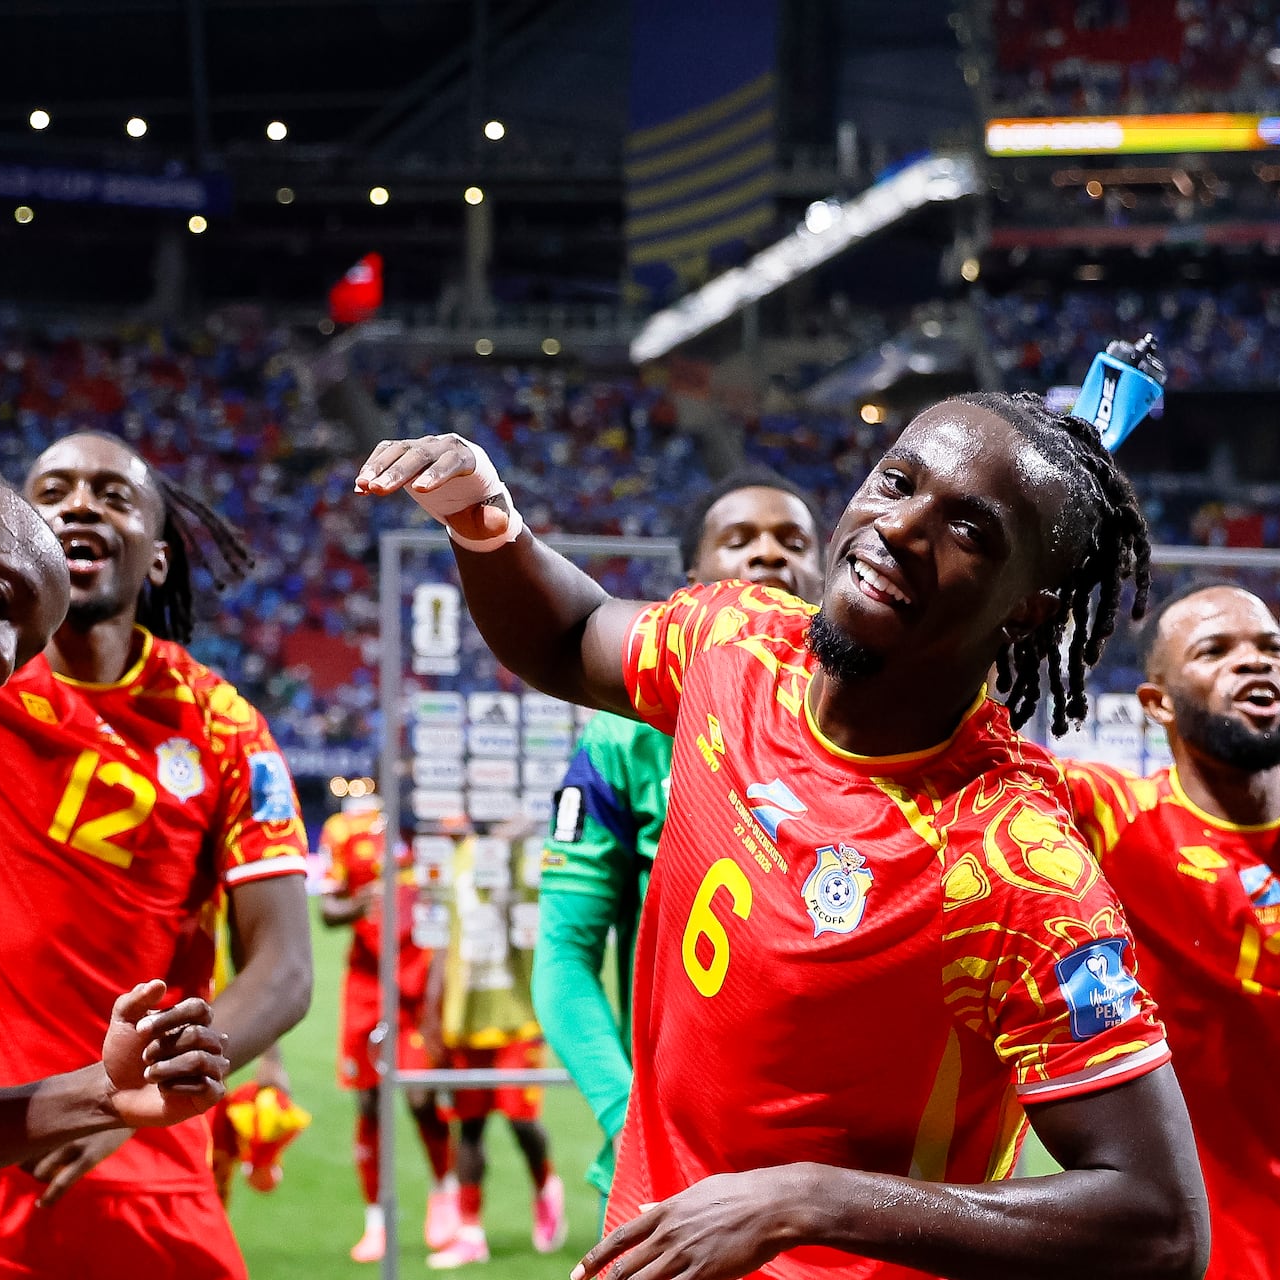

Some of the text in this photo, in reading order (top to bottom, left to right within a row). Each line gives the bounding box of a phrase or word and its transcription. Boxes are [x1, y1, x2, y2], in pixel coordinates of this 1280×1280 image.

[696, 733, 720, 773] umbro
[48, 748, 157, 869] 12
[733, 822, 746, 838] 27
[754, 850, 773, 874] 2026
[681, 857, 753, 998] 6
[810, 899, 845, 924] FECOFA
